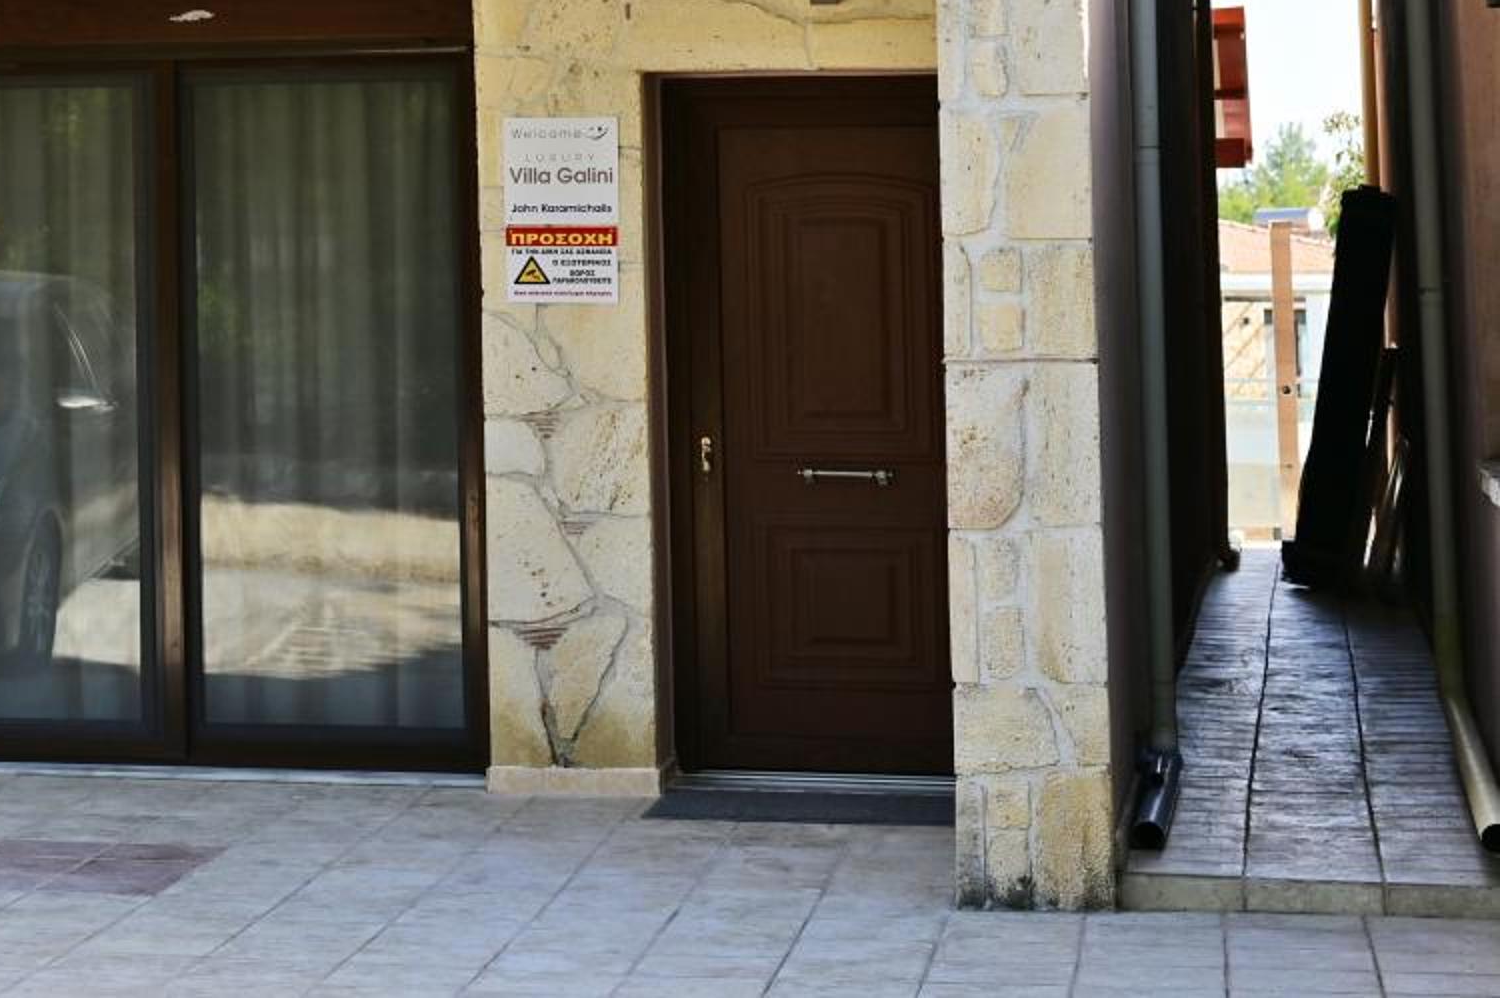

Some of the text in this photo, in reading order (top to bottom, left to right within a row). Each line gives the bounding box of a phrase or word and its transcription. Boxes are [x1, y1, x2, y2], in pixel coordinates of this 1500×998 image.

[512, 128, 582, 139] Welcome
[509, 167, 613, 184] Villa Galini
[512, 203, 538, 213] John
[511, 233, 612, 245] ΠΡΟΣΟΧΗ
